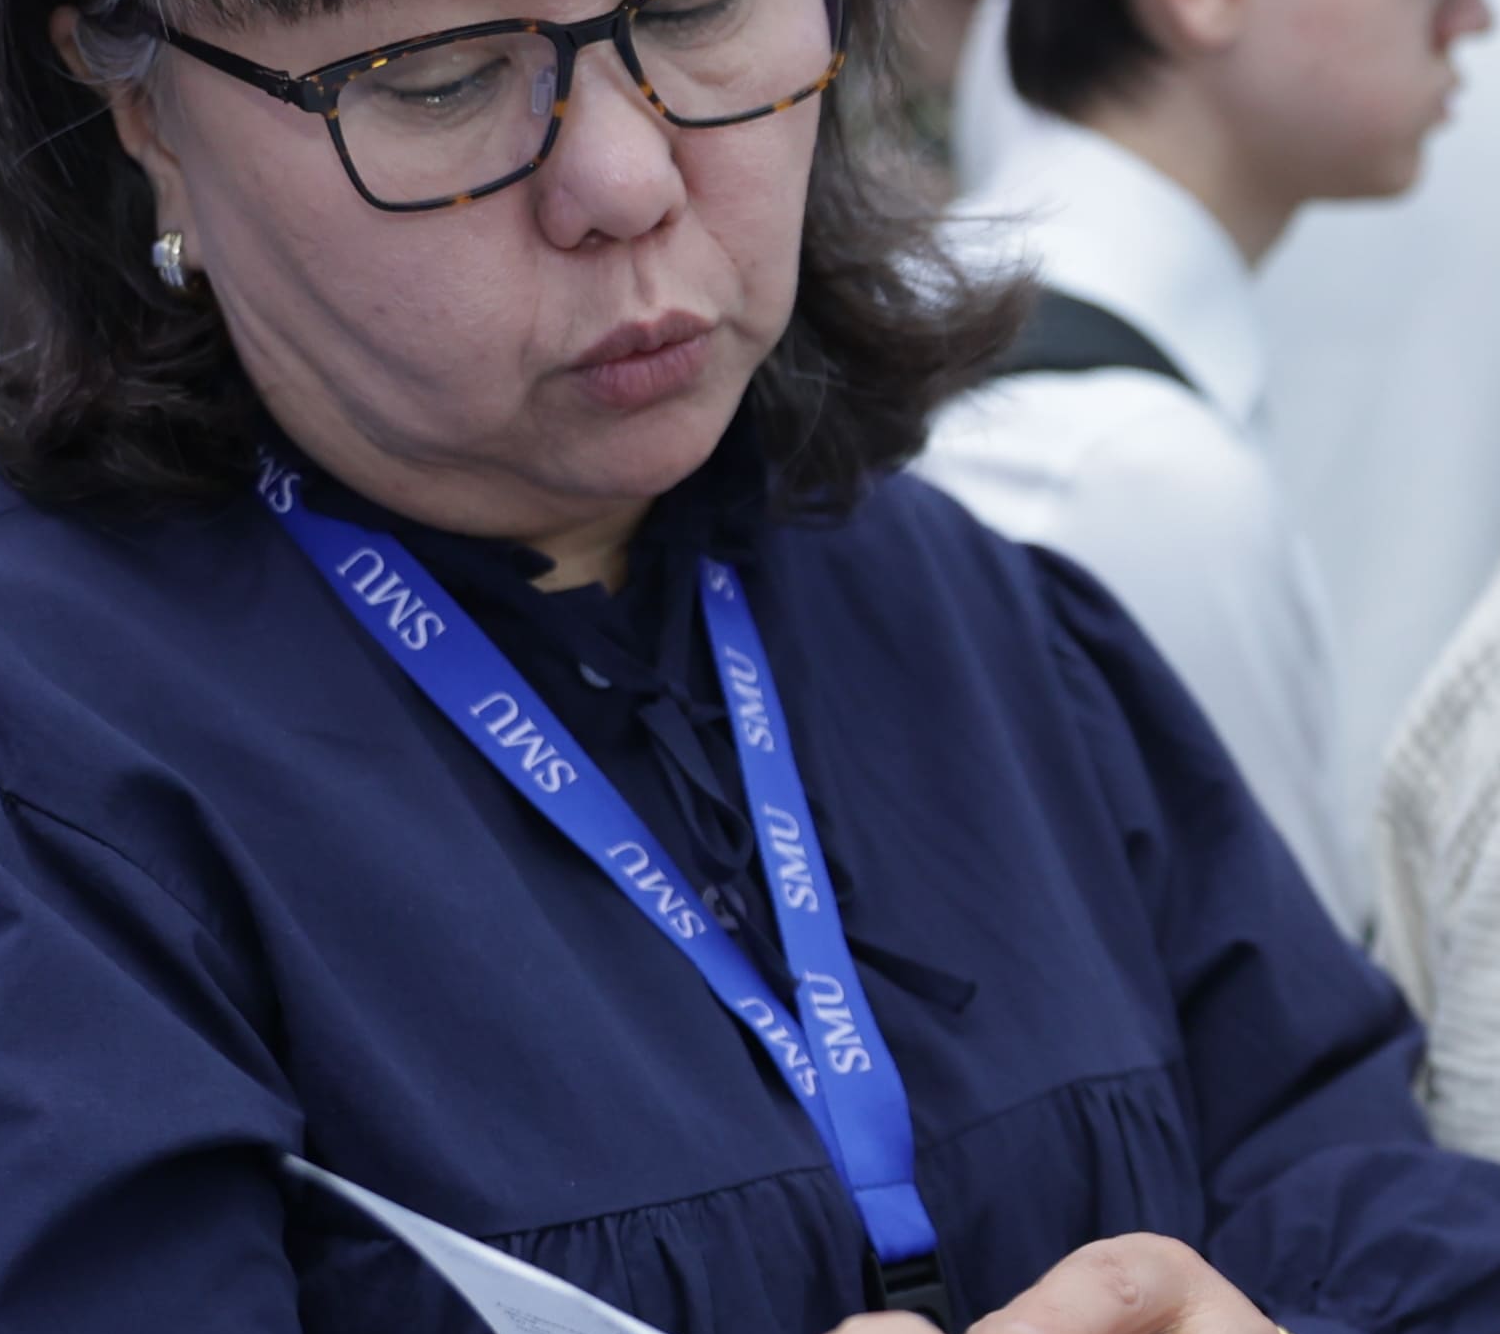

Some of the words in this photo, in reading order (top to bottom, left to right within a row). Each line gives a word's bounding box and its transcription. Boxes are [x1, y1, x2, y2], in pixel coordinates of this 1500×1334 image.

[336, 547, 446, 652] SMU
[469, 691, 578, 795] SMU
[724, 646, 775, 753] SMU
[606, 841, 705, 941] SMU
[761, 805, 819, 914] SMU
[737, 996, 818, 1098] SMU
[804, 970, 871, 1075] SMU
